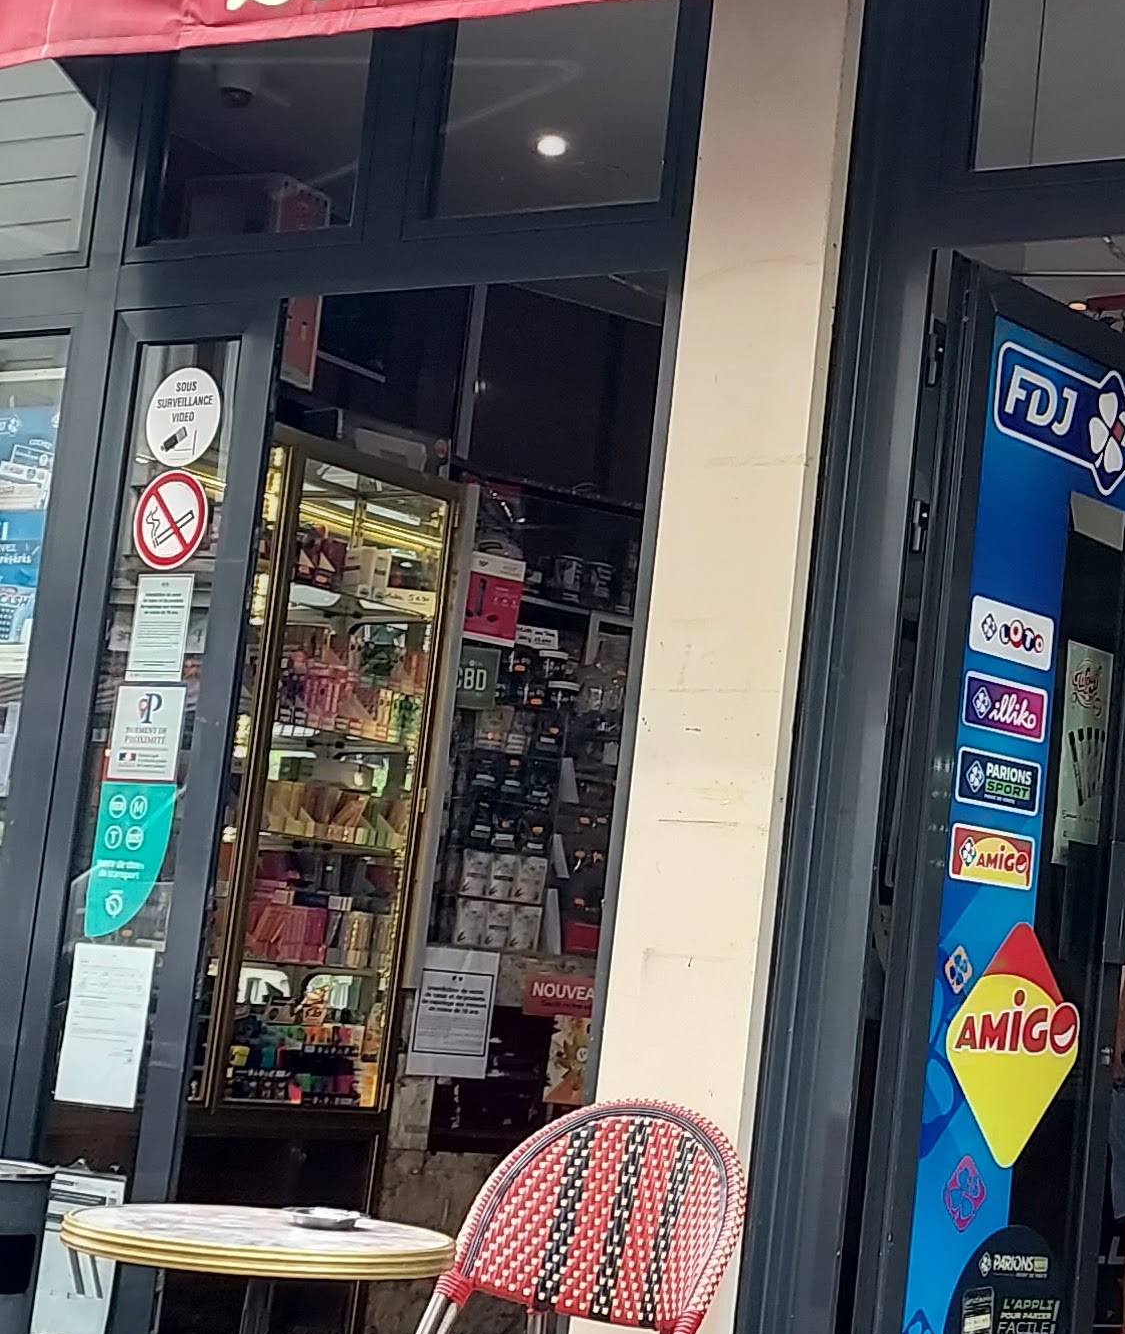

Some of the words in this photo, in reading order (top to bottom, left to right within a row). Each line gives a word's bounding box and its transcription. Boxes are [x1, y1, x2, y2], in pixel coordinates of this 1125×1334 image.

[176, 381, 197, 393] SOUS
[157, 395, 214, 409] SURVEILLANCE
[1004, 364, 1079, 437] FDJ
[1000, 620, 1044, 654] LOTO
[989, 694, 1037, 729] illiko
[986, 762, 1032, 786] PARIONS
[987, 781, 1029, 798] SPORT
[532, 981, 594, 1001] NOUVEA
[993, 1254, 1034, 1272] PARIONS
[1003, 1299, 1055, 1311] L'APPLI
